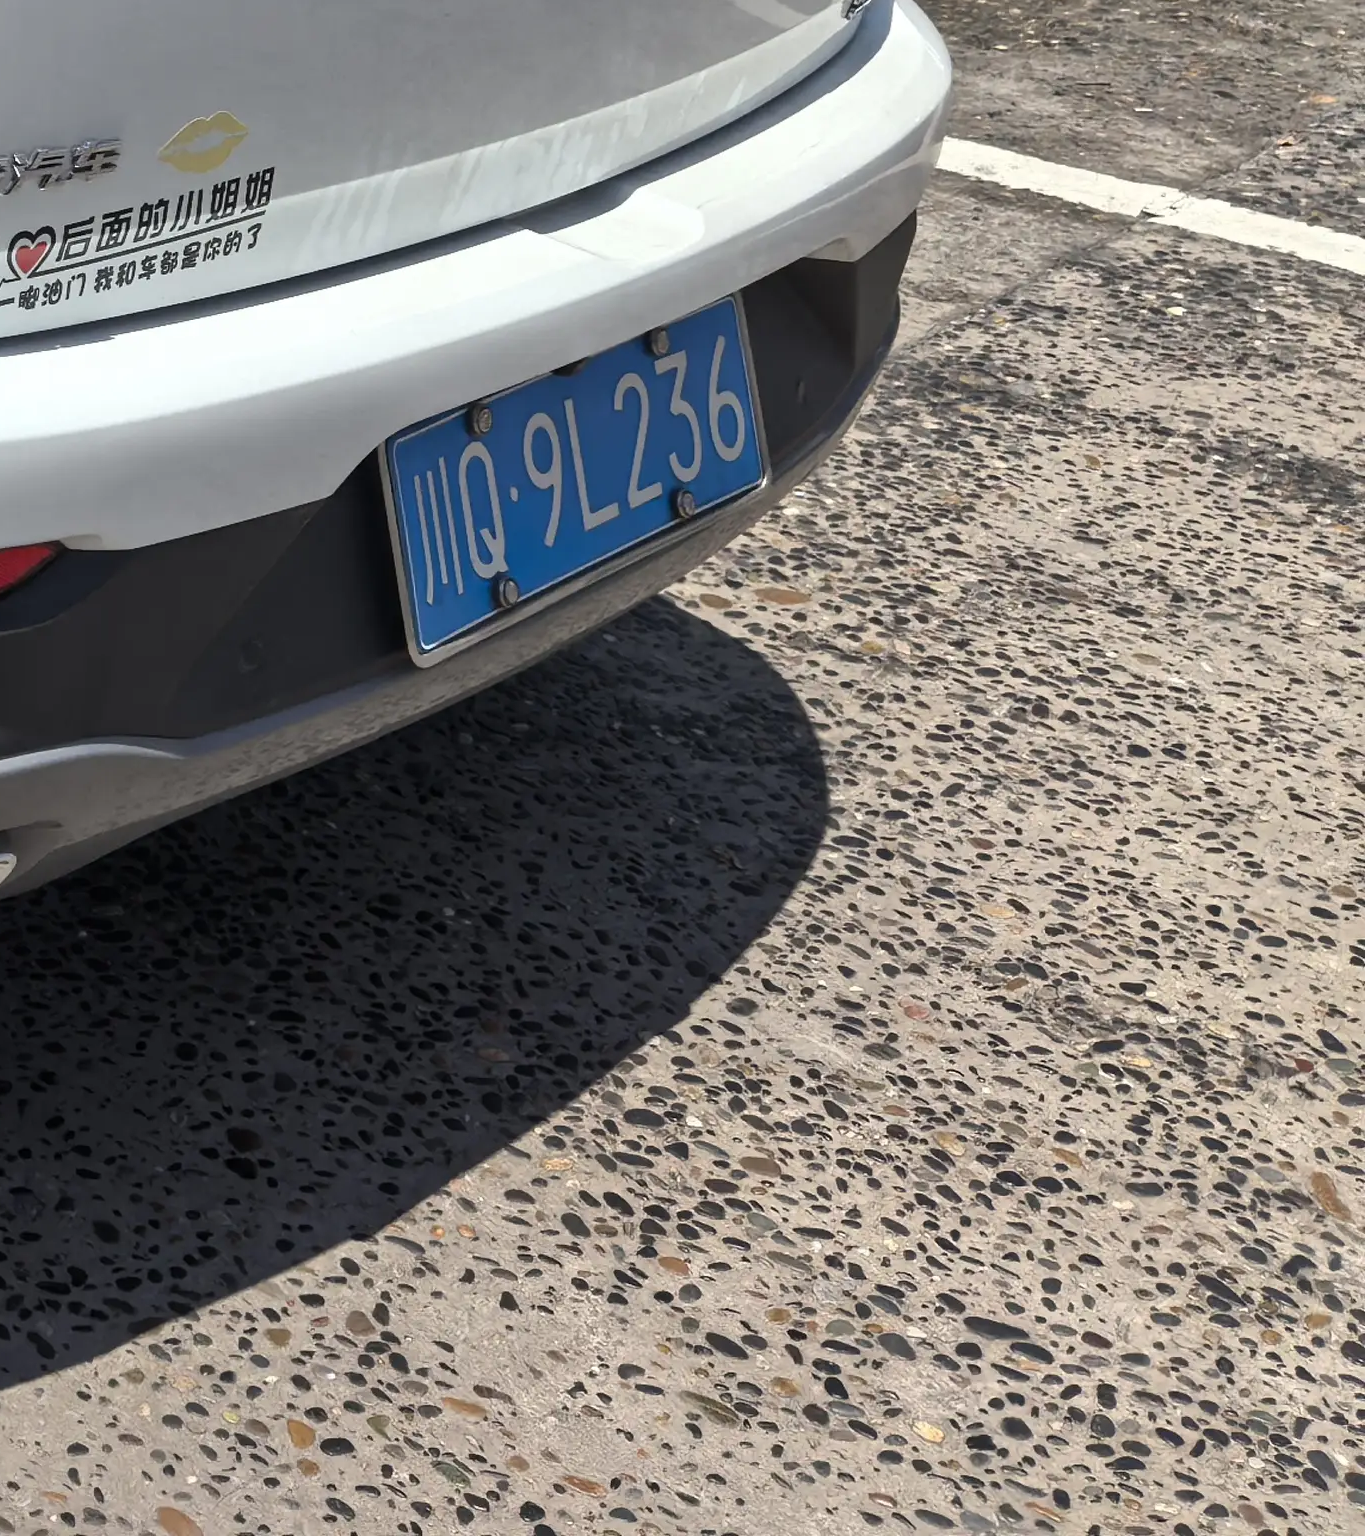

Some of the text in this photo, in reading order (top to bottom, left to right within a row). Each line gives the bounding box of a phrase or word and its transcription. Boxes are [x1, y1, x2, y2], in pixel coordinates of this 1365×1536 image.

[55, 166, 276, 262] 后面的小姐姐
[94, 223, 263, 294] 我和车都是你的了
